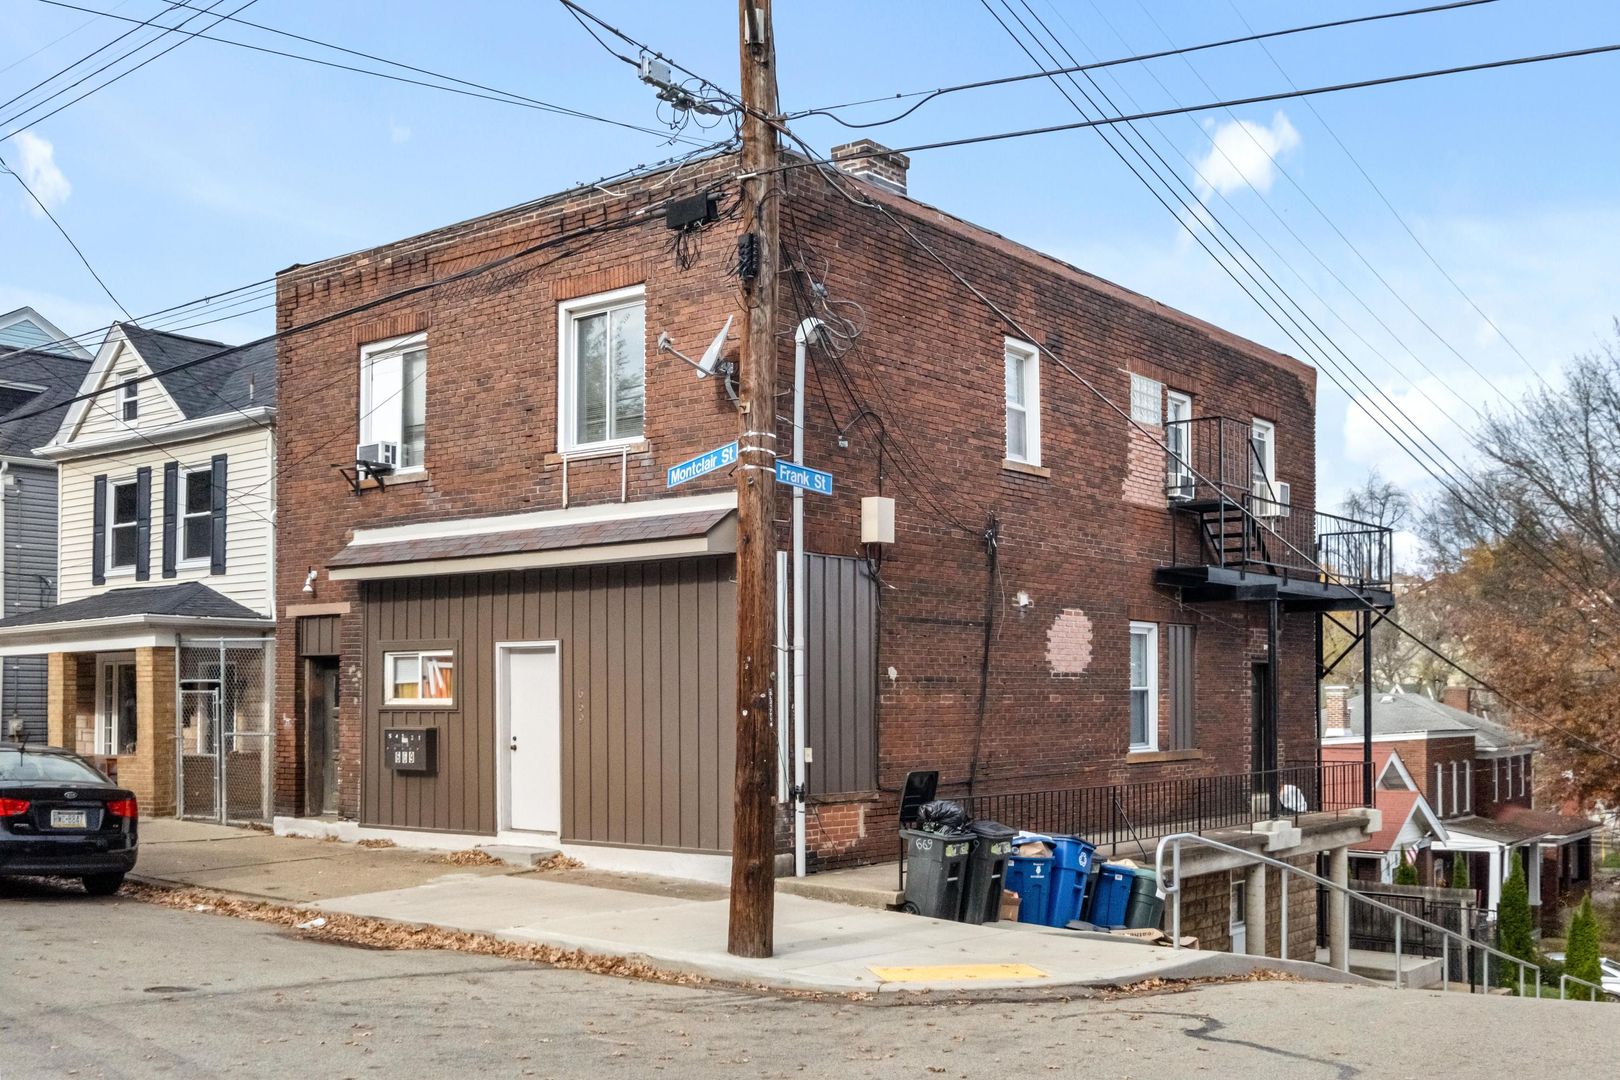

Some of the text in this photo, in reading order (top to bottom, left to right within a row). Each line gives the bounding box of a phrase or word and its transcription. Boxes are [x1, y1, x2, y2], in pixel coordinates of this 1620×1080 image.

[670, 446, 733, 484] Montclair St
[780, 465, 826, 491] Frank St
[915, 838, 933, 850] 669
